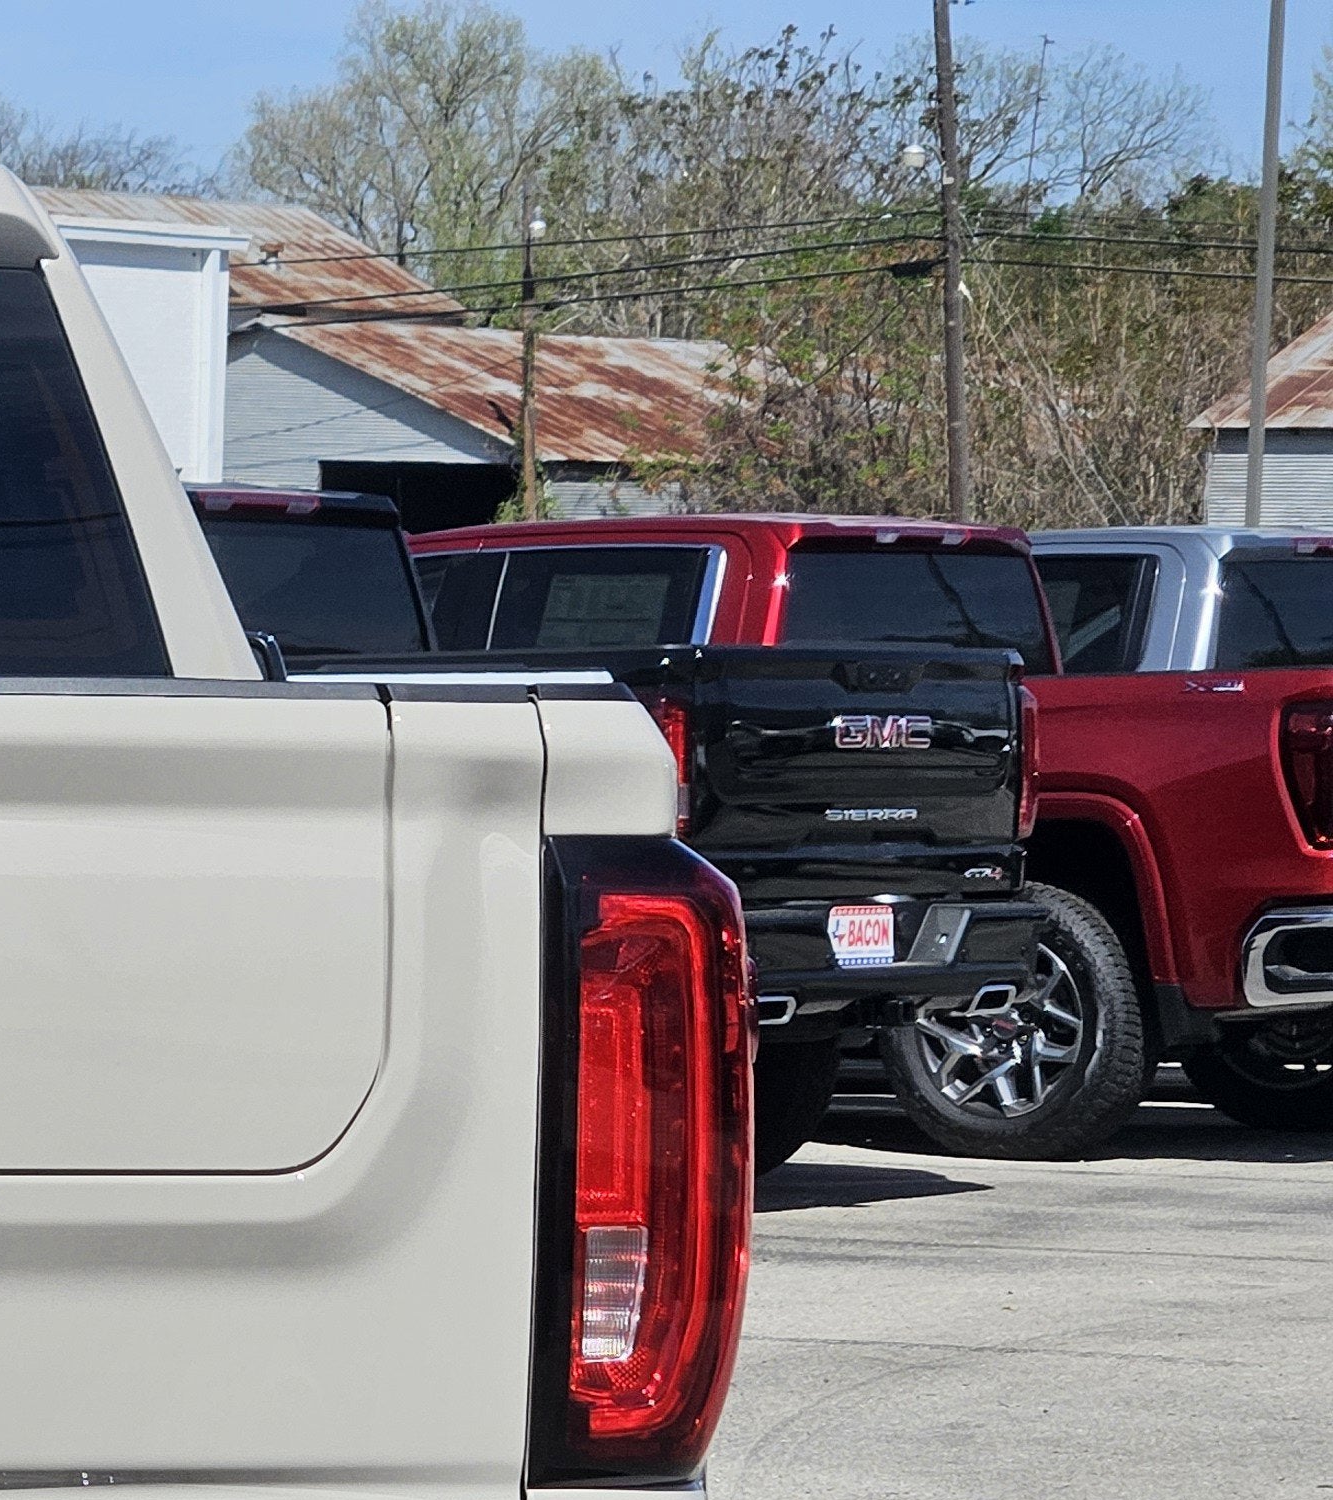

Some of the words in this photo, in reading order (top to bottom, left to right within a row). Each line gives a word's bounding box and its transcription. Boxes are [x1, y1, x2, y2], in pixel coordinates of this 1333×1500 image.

[833, 714, 932, 749] GMC
[824, 808, 918, 821] SIERRA
[847, 918, 890, 947] BACON
